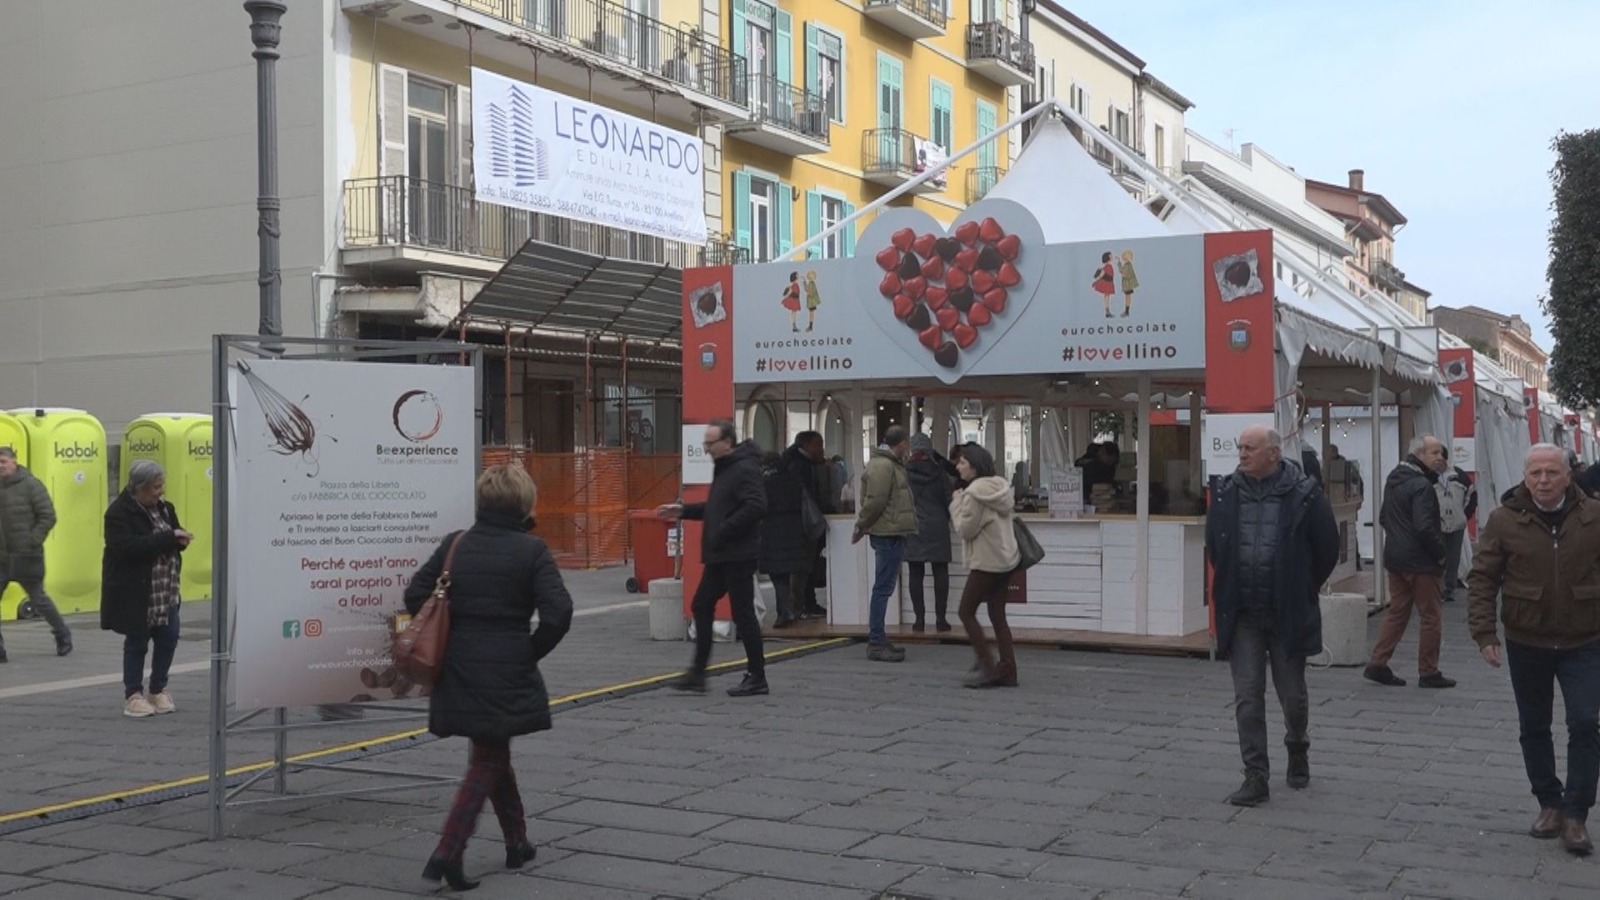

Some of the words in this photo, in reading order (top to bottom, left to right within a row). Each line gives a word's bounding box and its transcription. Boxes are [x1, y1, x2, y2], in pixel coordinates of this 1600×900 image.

[555, 101, 699, 175] LEONARDO
[576, 149, 652, 180] EDILIZIA
[1061, 323, 1176, 336] eurochocolate
[755, 337, 853, 349] eurochocolate
[54, 441, 99, 458] kobak
[188, 441, 213, 456] kob
[129, 437, 160, 452] kobak
[376, 444, 459, 457] Beexperience
[320, 480, 348, 490] Piazza
[350, 480, 370, 489] della
[291, 492, 308, 501] c/o
[310, 491, 350, 501] FABBRICA
[352, 491, 367, 500] DEL
[369, 490, 427, 500] CIOCCOLATO
[280, 512, 315, 523] Apriamo
[316, 511, 325, 520] le
[326, 512, 349, 522] porte
[351, 510, 371, 520] della
[373, 510, 409, 520] Fabbrica
[411, 509, 439, 519] BeWell
[288, 526, 295, 534] e
[305, 524, 341, 533] invitiamo
[343, 525, 350, 533] a
[351, 522, 382, 532] lasciarti
[383, 522, 430, 534] conquistare
[271, 537, 286, 547] dal
[287, 536, 318, 546] fascino
[320, 535, 335, 545] del
[336, 535, 358, 545] Buon
[358, 535, 403, 544] Cioccolato
[405, 534, 413, 543] di
[301, 556, 346, 571] Perché
[349, 555, 418, 571] quest'anno
[310, 577, 342, 590] sarai
[345, 576, 393, 590] proprio
[395, 574, 410, 587] Tu
[338, 598, 347, 607] a
[308, 657, 393, 670] www.eurochocolate
